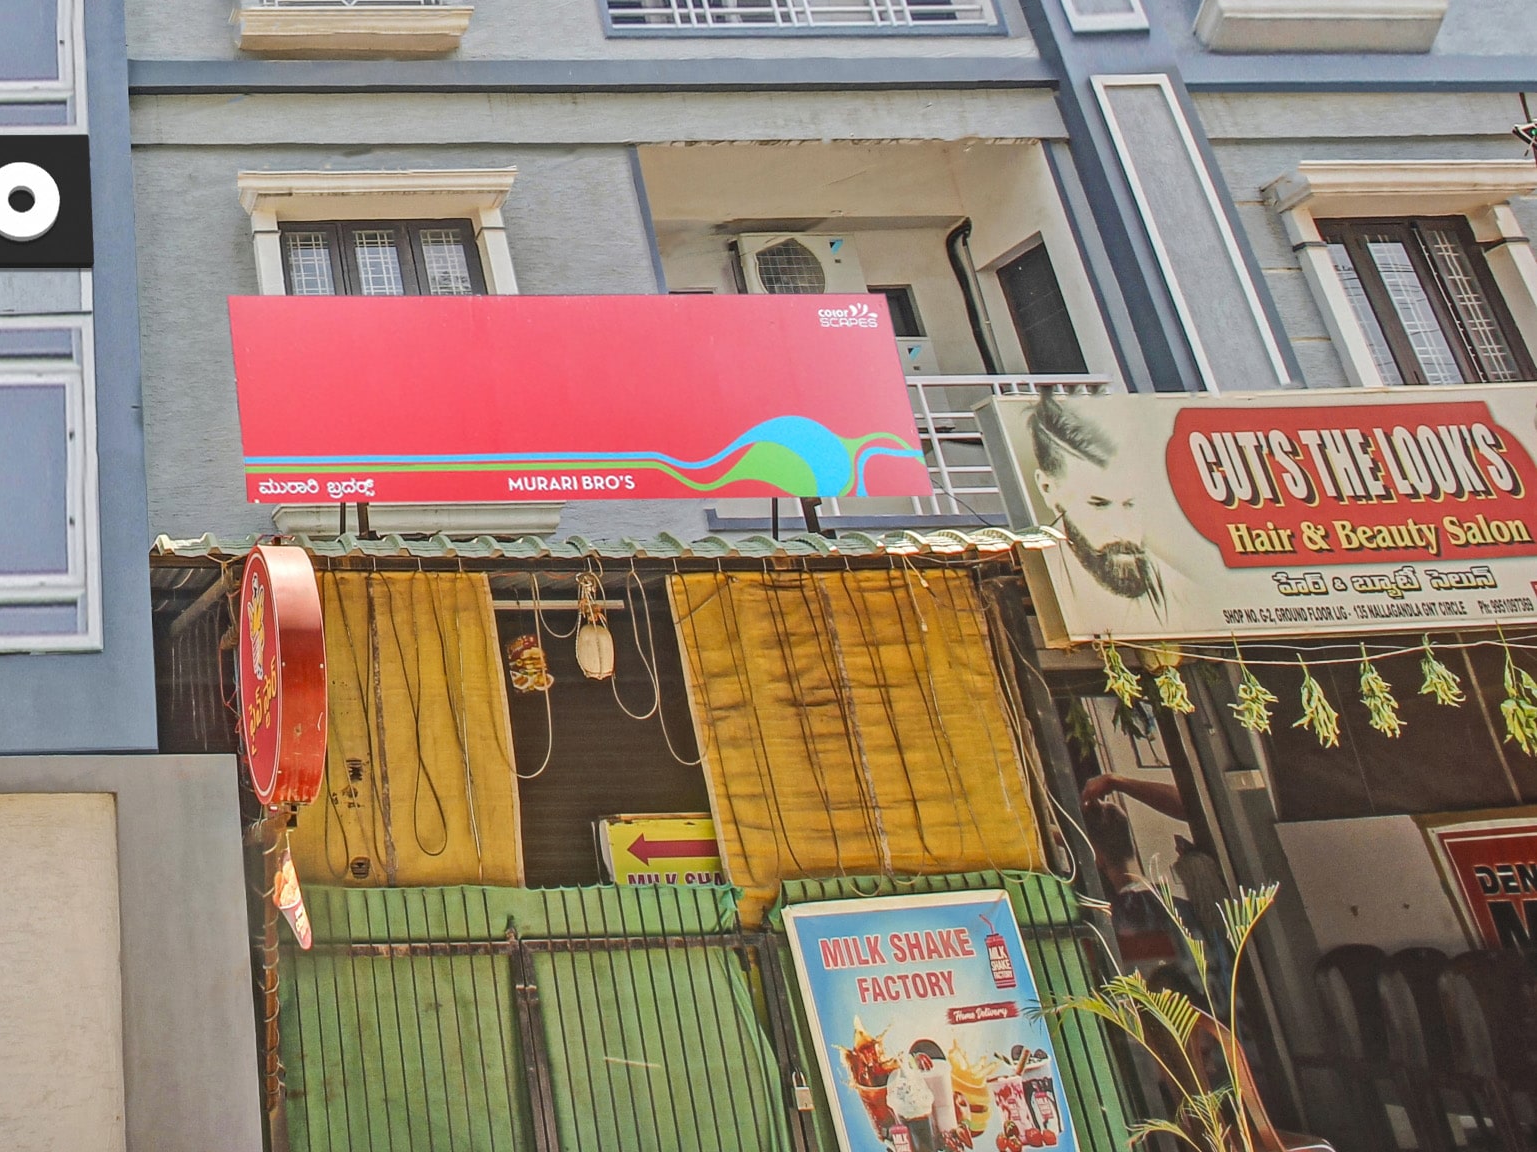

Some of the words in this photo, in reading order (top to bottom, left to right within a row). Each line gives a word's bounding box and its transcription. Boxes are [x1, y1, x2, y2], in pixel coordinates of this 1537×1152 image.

[1189, 428, 1315, 505] CUT'S
[1297, 428, 1391, 501] THE
[1372, 422, 1520, 499] LOOK'S
[507, 476, 579, 491] MURARI
[581, 475, 636, 490] BRO'S
[1226, 521, 1294, 553] Hair
[1300, 520, 1327, 551] &
[1332, 517, 1438, 556] Beauty
[1442, 513, 1533, 546] Salon
[1332, 576, 1348, 592] &
[1222, 608, 1244, 624] SHOP
[1244, 608, 1260, 623] NO.
[1259, 607, 1277, 625] G-2,
[1274, 606, 1308, 622] GROUND
[1307, 605, 1333, 621] FLOOR
[1331, 605, 1349, 620] LIG
[1353, 604, 1370, 619] 135
[1368, 600, 1423, 619] NALLAGANDLA
[1420, 600, 1440, 617] GNT
[1437, 600, 1468, 616] CIRCLE
[819, 935, 887, 969] MILK
[889, 927, 976, 963] SHAKE
[856, 970, 956, 1004] FACTORY
